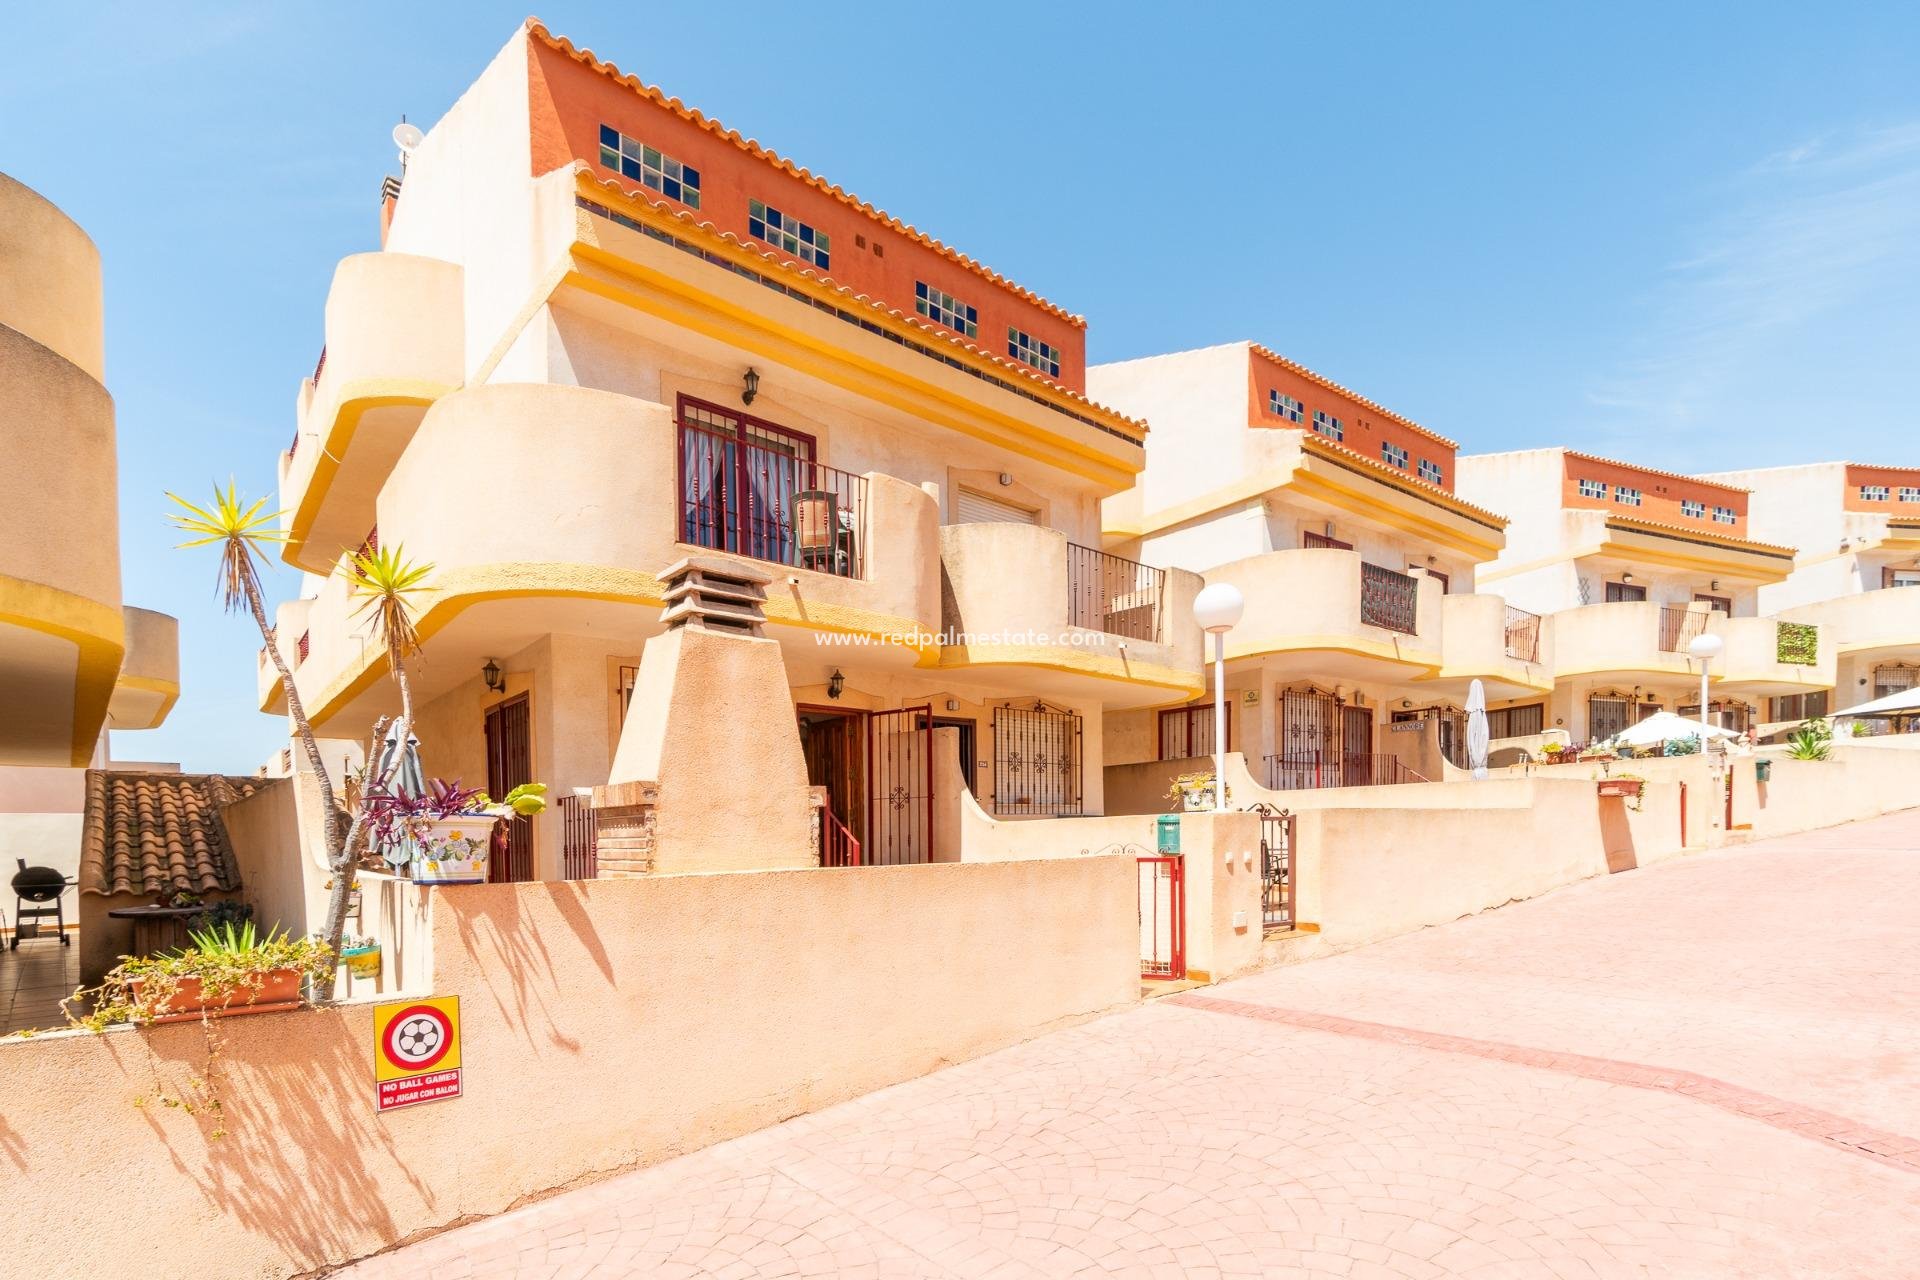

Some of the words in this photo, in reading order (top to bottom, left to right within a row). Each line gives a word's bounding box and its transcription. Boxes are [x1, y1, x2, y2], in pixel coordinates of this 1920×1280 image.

[383, 1083, 397, 1092] NO
[400, 1078, 423, 1089] BALL
[425, 1072, 457, 1084] GAMES
[383, 1097, 394, 1105] NO
[395, 1092, 419, 1103] JUGAR
[420, 1088, 435, 1098] CON
[436, 1084, 458, 1093] BALON
